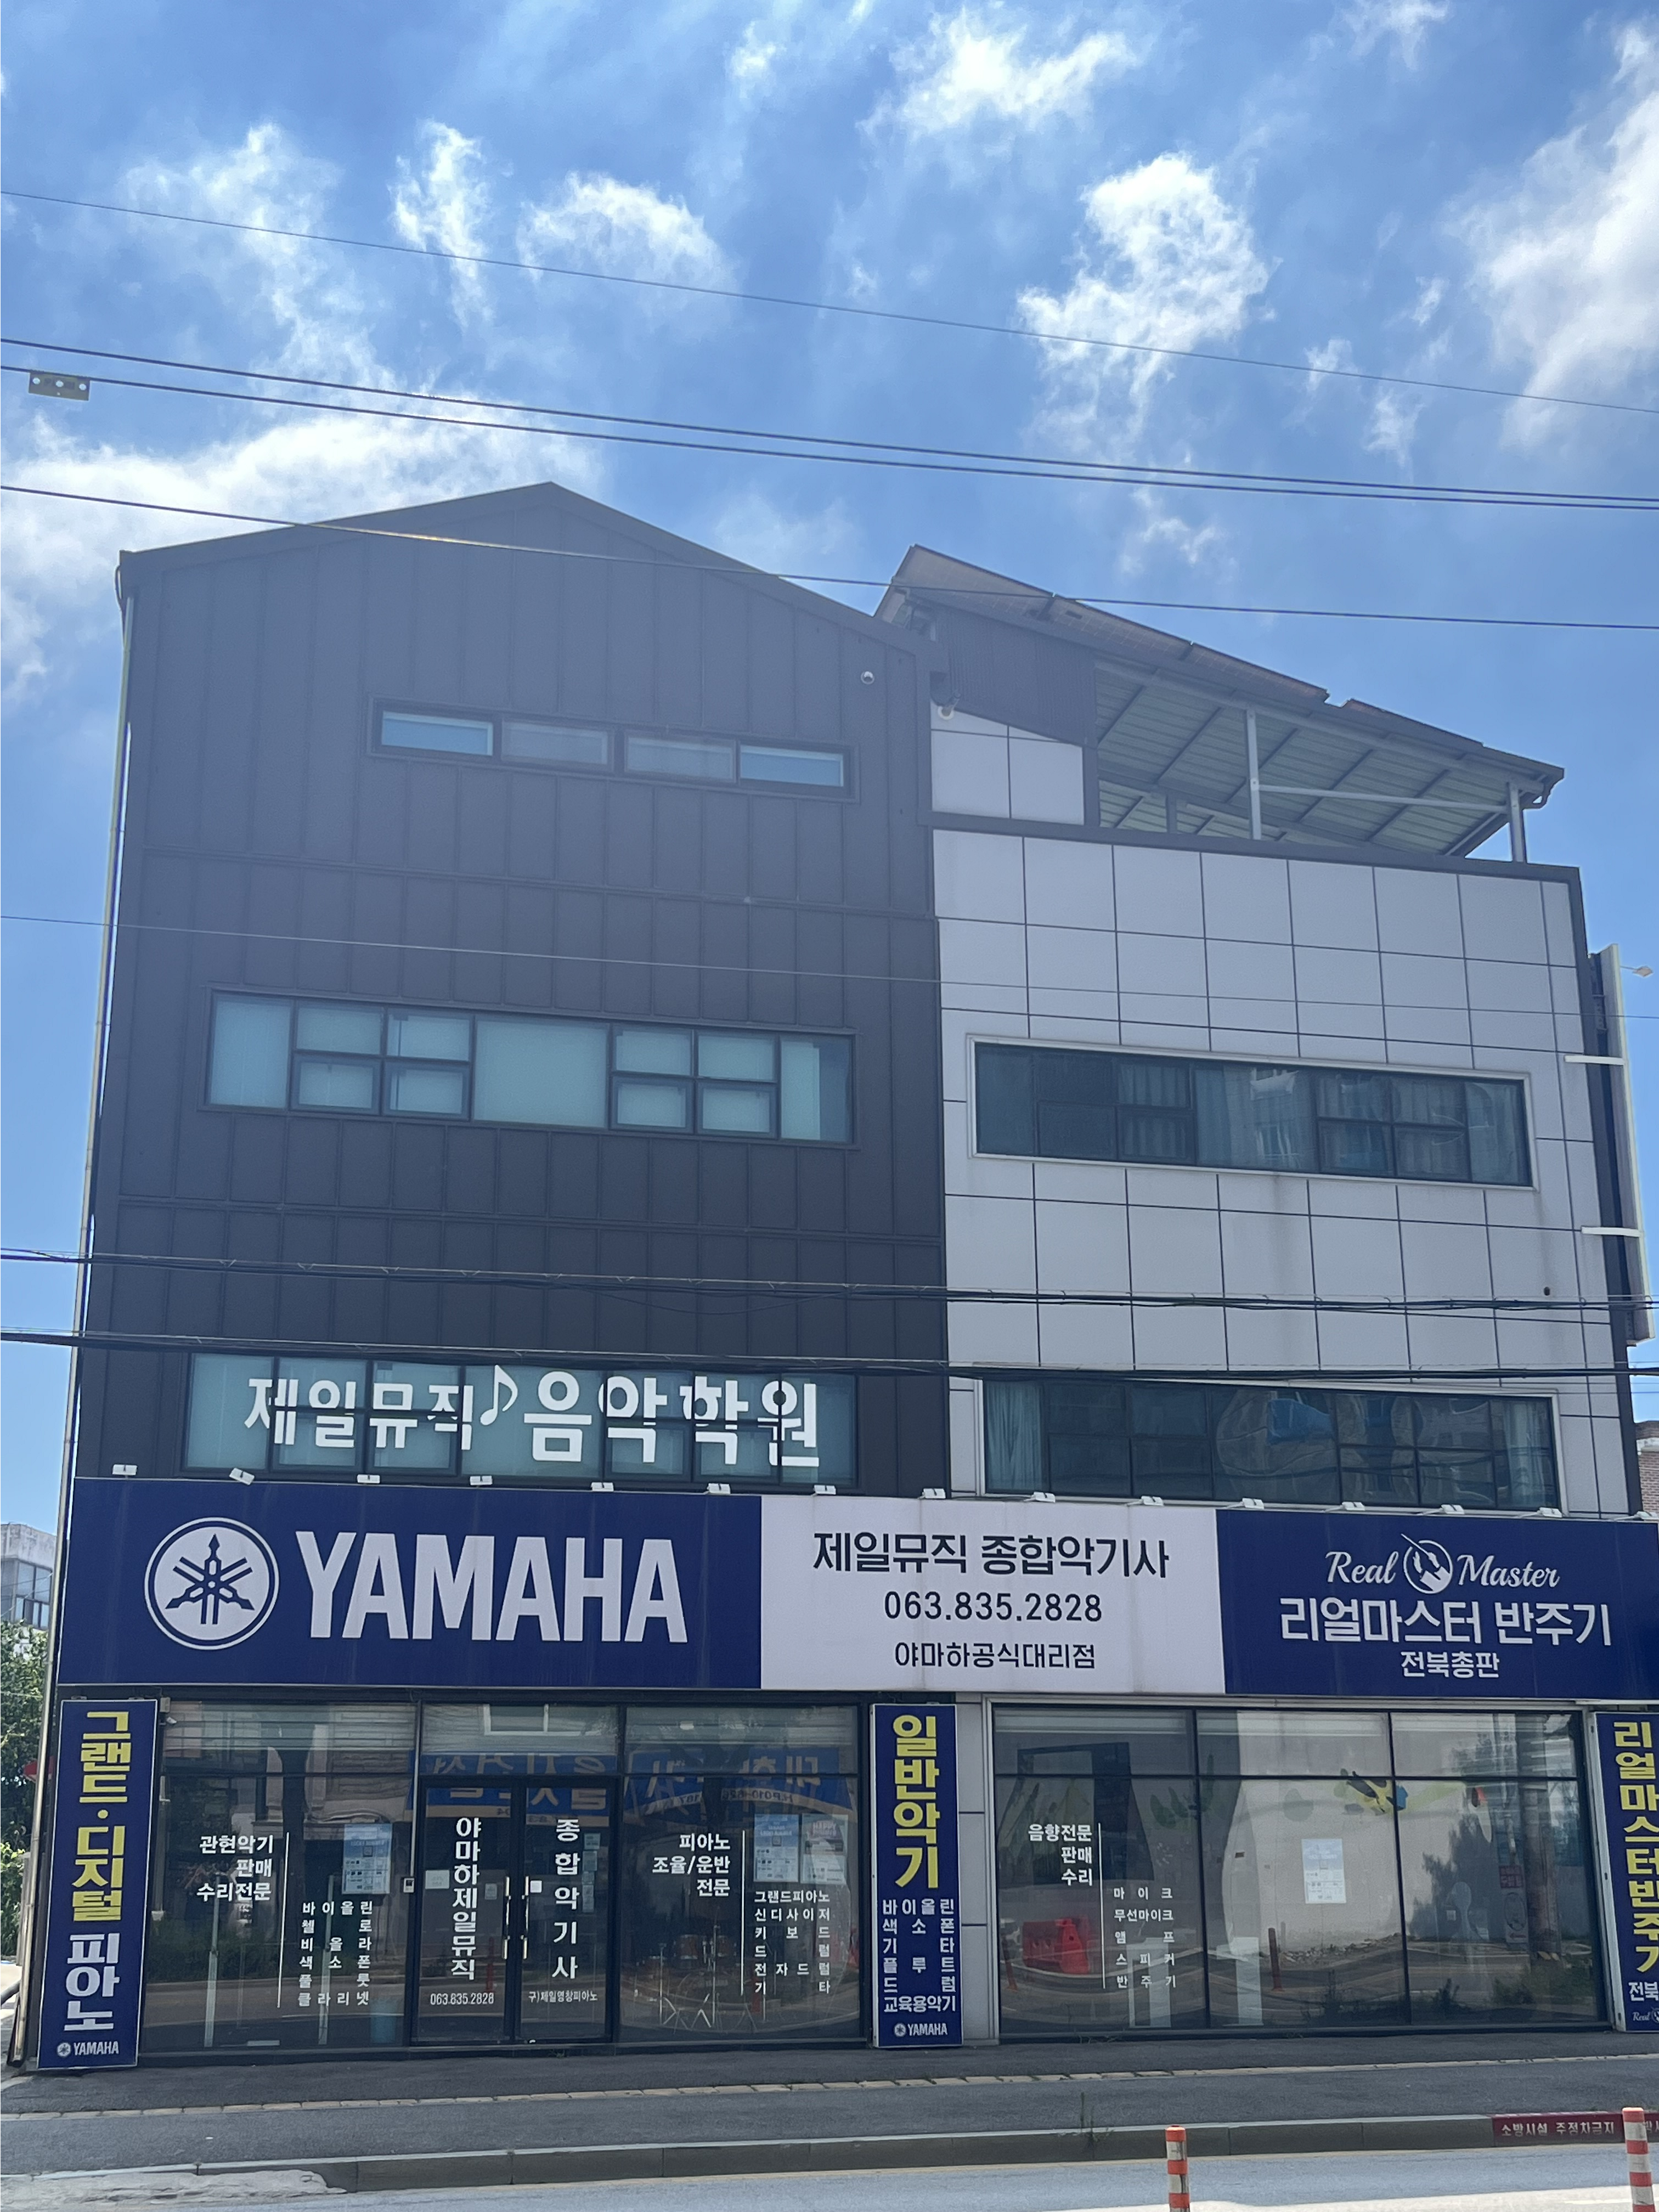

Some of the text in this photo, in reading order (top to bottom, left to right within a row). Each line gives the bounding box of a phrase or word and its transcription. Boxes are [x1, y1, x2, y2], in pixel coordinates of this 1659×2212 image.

[244, 1370, 820, 1468] 제일뮤직 음악학원
[813, 1531, 1170, 1578] 제일뮤직 종합악기사
[1325, 1550, 1561, 1589] Real Master
[295, 1531, 689, 1644] YAMAHA
[884, 1590, 1103, 1622] 063.835.2828
[1280, 1596, 1611, 1646] 리얼마스터 반주기
[895, 1641, 1096, 1669] 야마하공식대리점
[1401, 1651, 1500, 1679] 전북총판
[893, 1714, 940, 1888] 일반악기
[679, 1832, 730, 1851] 피아노
[1028, 1824, 1092, 1842] 음향전문
[199, 1835, 274, 1854] 관현악기
[652, 1855, 730, 1875] 조율/운반
[1061, 1847, 1092, 1864] 판매
[236, 1858, 272, 1877] 판매
[1061, 1868, 1093, 1886] 수리
[196, 1882, 272, 1902] 수리전문
[697, 1878, 730, 1897] 전문
[754, 1890, 830, 1904] 그랜드피아노
[302, 1900, 373, 1916] 바이올린
[451, 1818, 481, 1980] 야마하제일뮤직
[552, 1819, 580, 1979] 종합악기사
[882, 1898, 954, 1915] 바이올린
[754, 1908, 830, 1922] 신디사이저
[1114, 1909, 1173, 1922] 무선마이크
[64, 1933, 120, 2031] 피아노
[430, 1992, 494, 2005] 063.835.2828
[884, 1995, 956, 2012] 교육용악기
[907, 2023, 947, 2036] YAMAHA
[74, 2041, 120, 2056] YAMAHA
[1502, 2121, 1614, 2137] 소방시설 주정차금지
